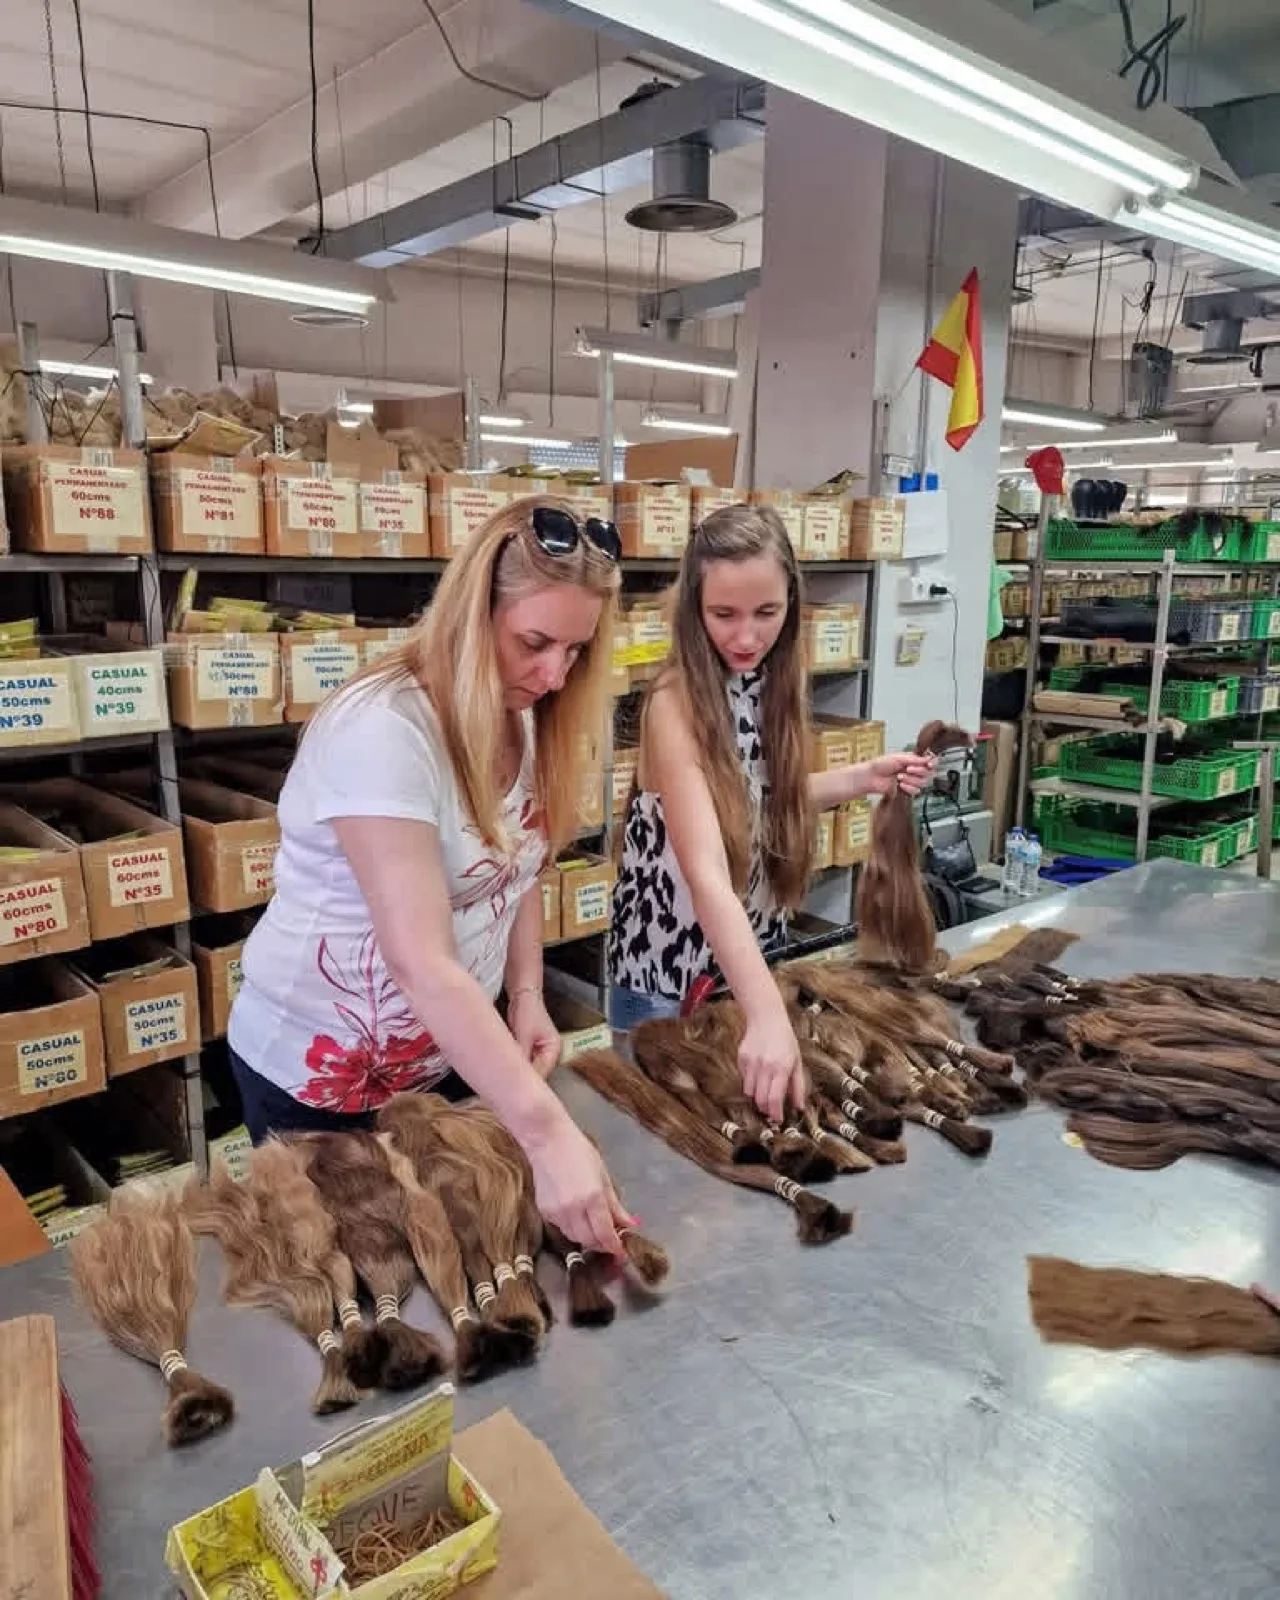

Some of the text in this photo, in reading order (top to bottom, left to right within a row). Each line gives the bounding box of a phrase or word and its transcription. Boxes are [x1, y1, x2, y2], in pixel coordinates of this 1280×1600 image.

[91, 667, 147, 679] CASUAL
[97, 686, 142, 696] 40cms
[2, 696, 51, 708] 50cms
[112, 852, 166, 868] CASUAL
[117, 869, 160, 882] 60cms
[3, 903, 52, 920] 60cms
[128, 998, 181, 1016] CASUAL
[134, 1016, 174, 1030] 50cms
[21, 1035, 80, 1055] CASUAL
[27, 1055, 74, 1070] 50cms
